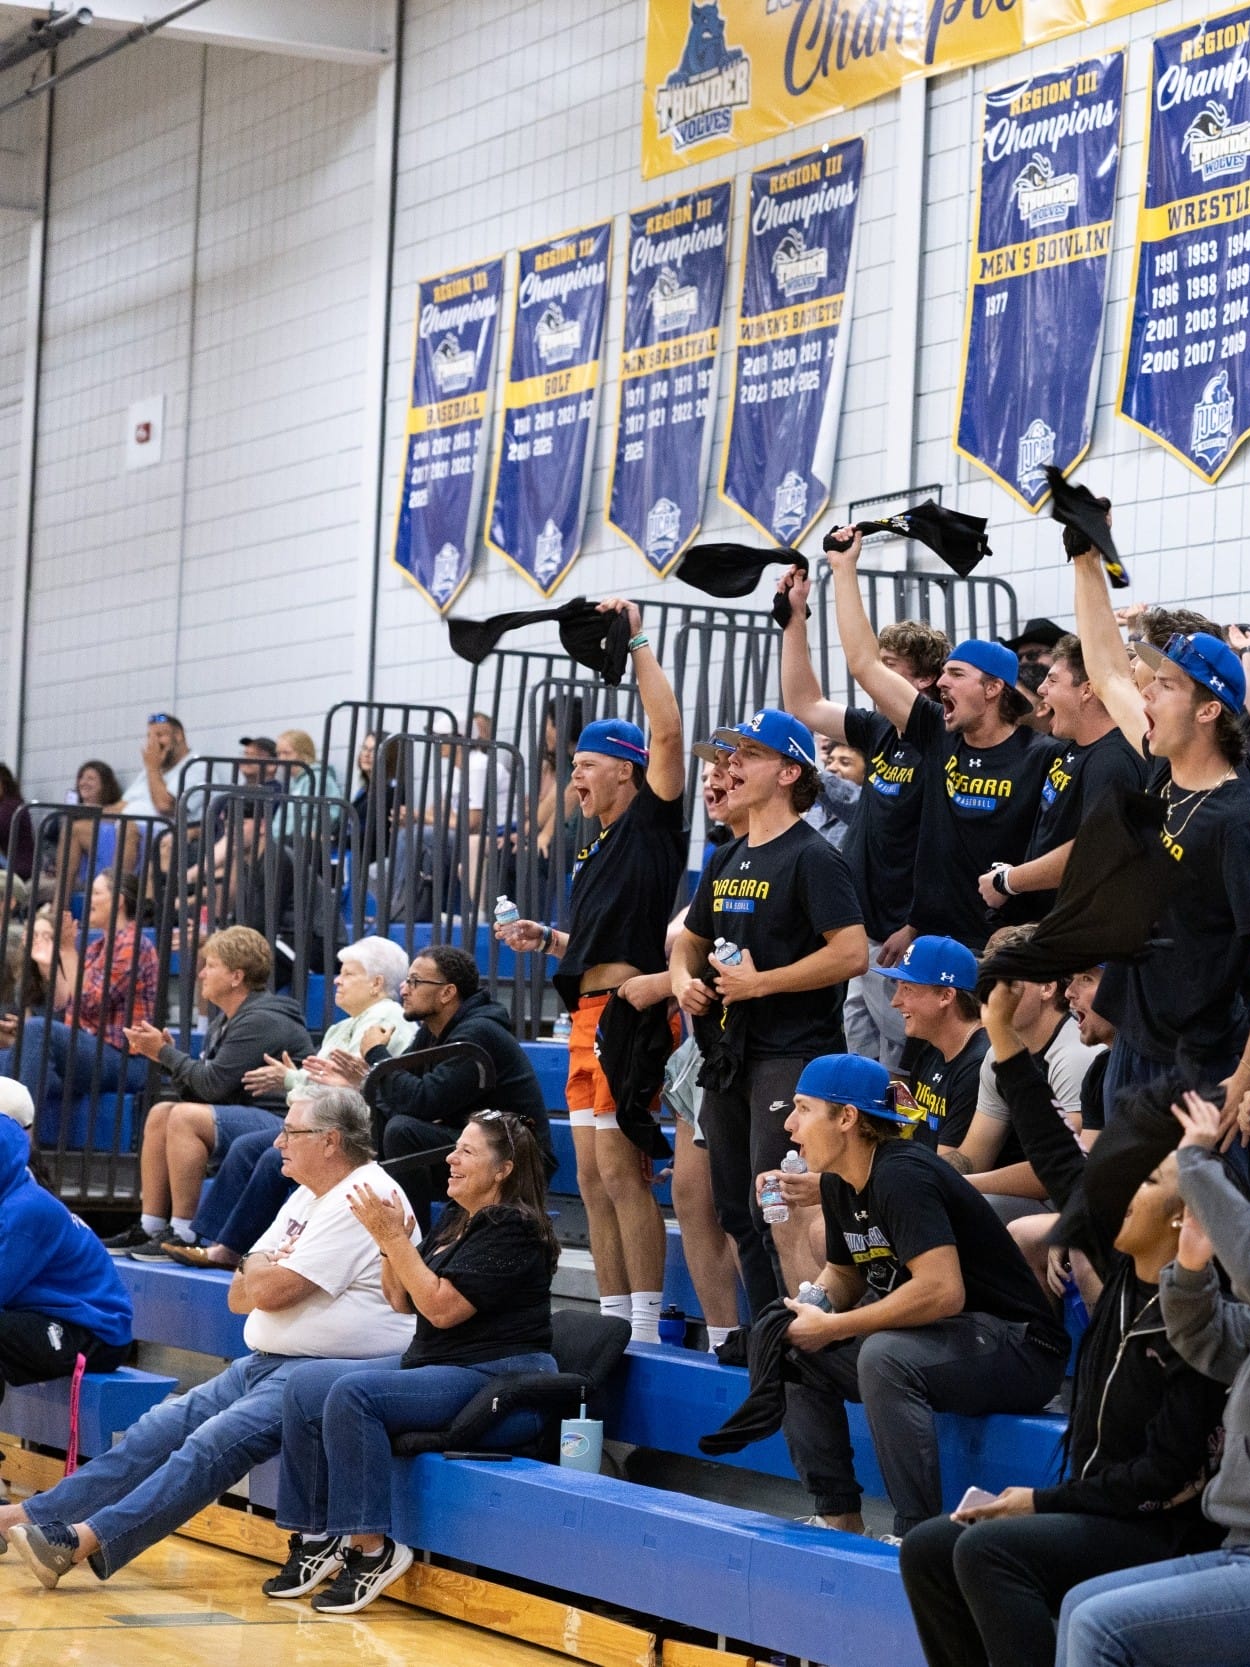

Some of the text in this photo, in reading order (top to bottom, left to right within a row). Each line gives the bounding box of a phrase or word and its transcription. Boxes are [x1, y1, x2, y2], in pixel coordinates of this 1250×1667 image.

[784, 0, 1016, 96] Champ
[1181, 20, 1250, 63] REGION
[658, 60, 748, 132] THUNDER
[1009, 71, 1098, 117] REGION III
[674, 108, 731, 146] WOLVES
[986, 100, 1118, 163] Champions
[769, 154, 844, 195] REGION III
[1205, 153, 1246, 175] WOLVES
[646, 198, 712, 235] REGION III
[752, 181, 858, 236] Champions
[535, 243, 576, 273] REGION
[631, 222, 726, 276] Champions
[979, 246, 1031, 279] MEN'S
[1155, 249, 1178, 277] 1991
[1187, 240, 1218, 268] 1993
[519, 261, 605, 309] Champions
[1152, 281, 1179, 309] 1996
[1186, 273, 1217, 301] 1998
[420, 294, 497, 338] Champions
[1145, 315, 1178, 342] 2001
[1185, 306, 1217, 334] 2003
[772, 347, 796, 371] 2020
[800, 341, 822, 364] 2021
[1141, 348, 1179, 374] 2006
[1184, 339, 1216, 368] 2007
[544, 373, 571, 397] GOLF
[426, 396, 480, 426] BASEBALL
